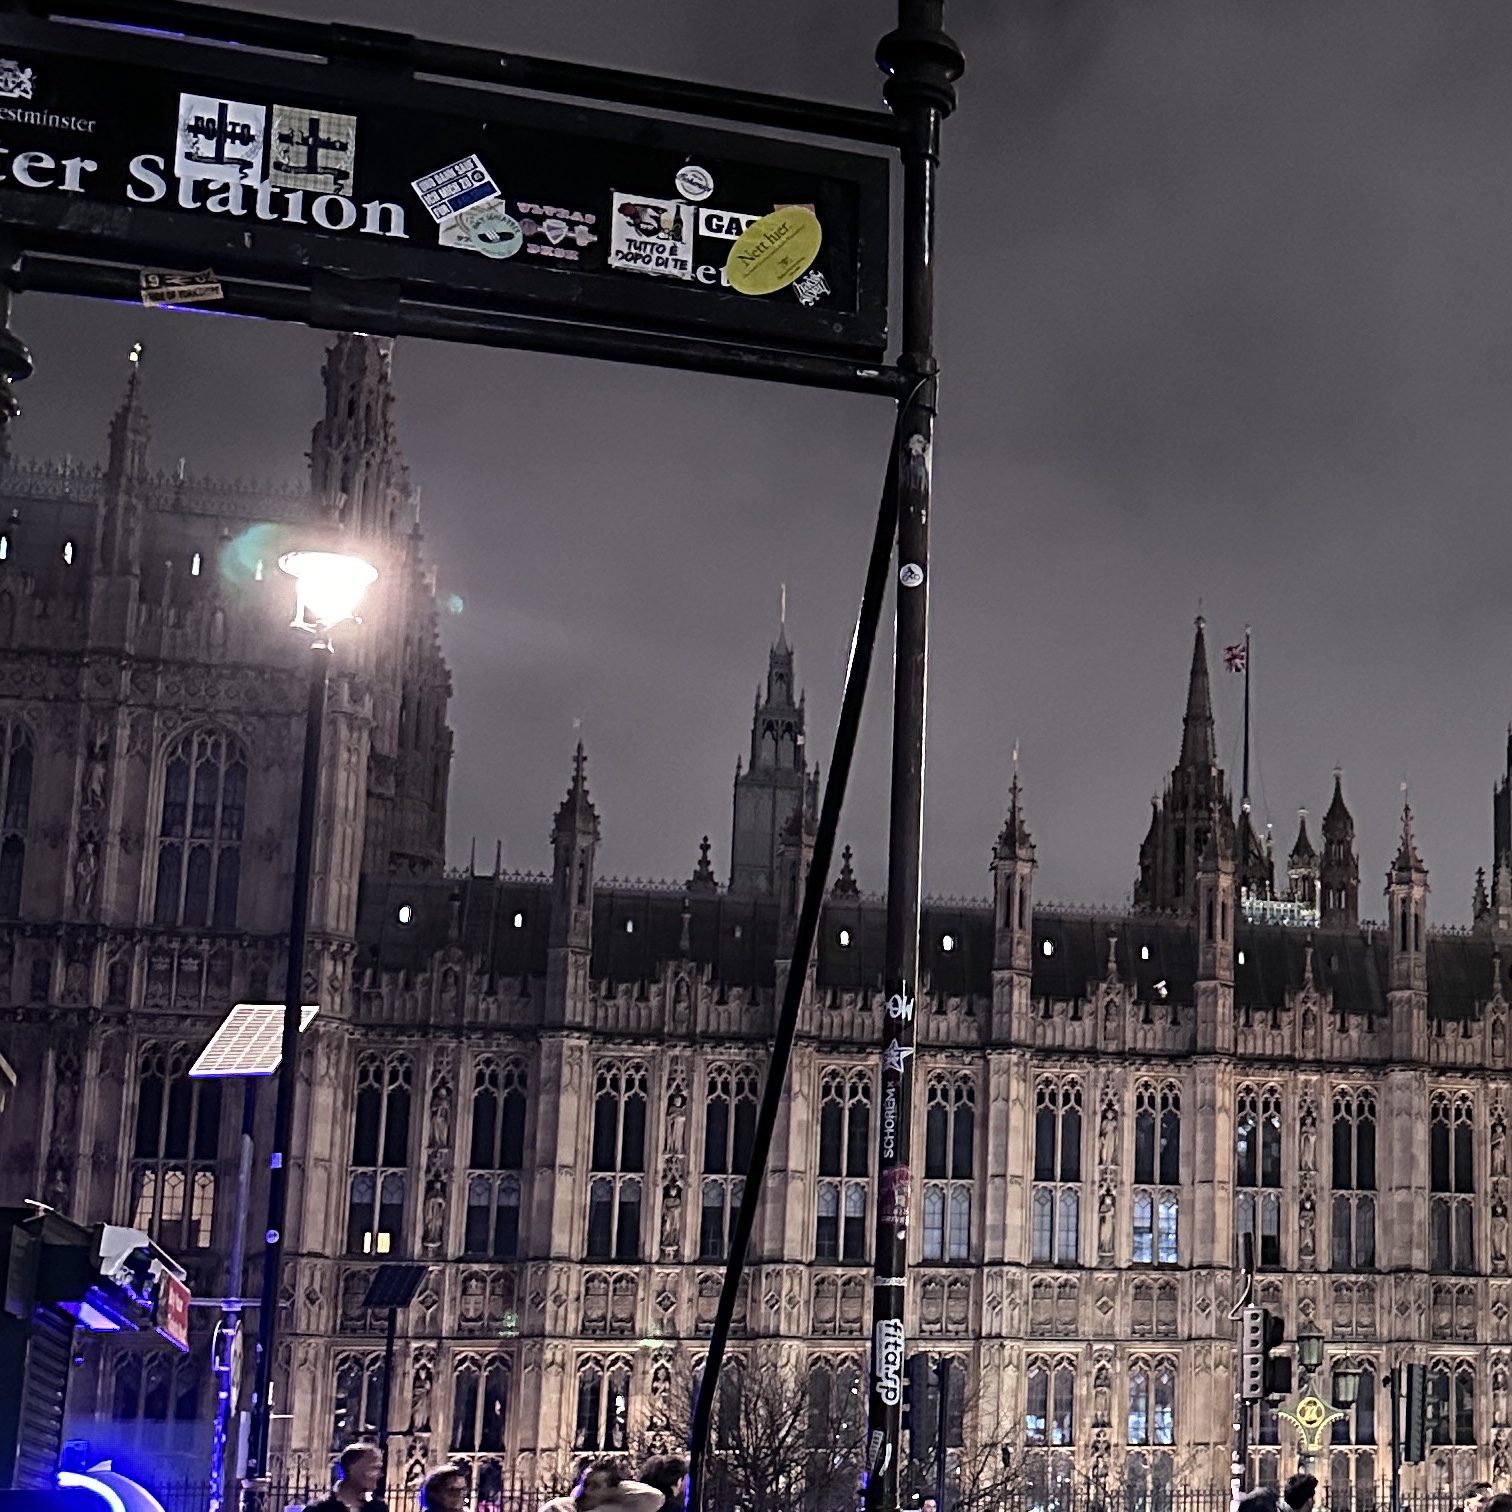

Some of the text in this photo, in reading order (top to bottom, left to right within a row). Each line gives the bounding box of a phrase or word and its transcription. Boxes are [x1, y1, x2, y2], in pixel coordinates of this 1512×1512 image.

[0, 147, 98, 193] er
[126, 154, 410, 239] Station
[704, 213, 757, 237] GA
[625, 238, 666, 255] TUTTO
[736, 240, 769, 267] Nett
[615, 249, 689, 271] DOPO DI TE
